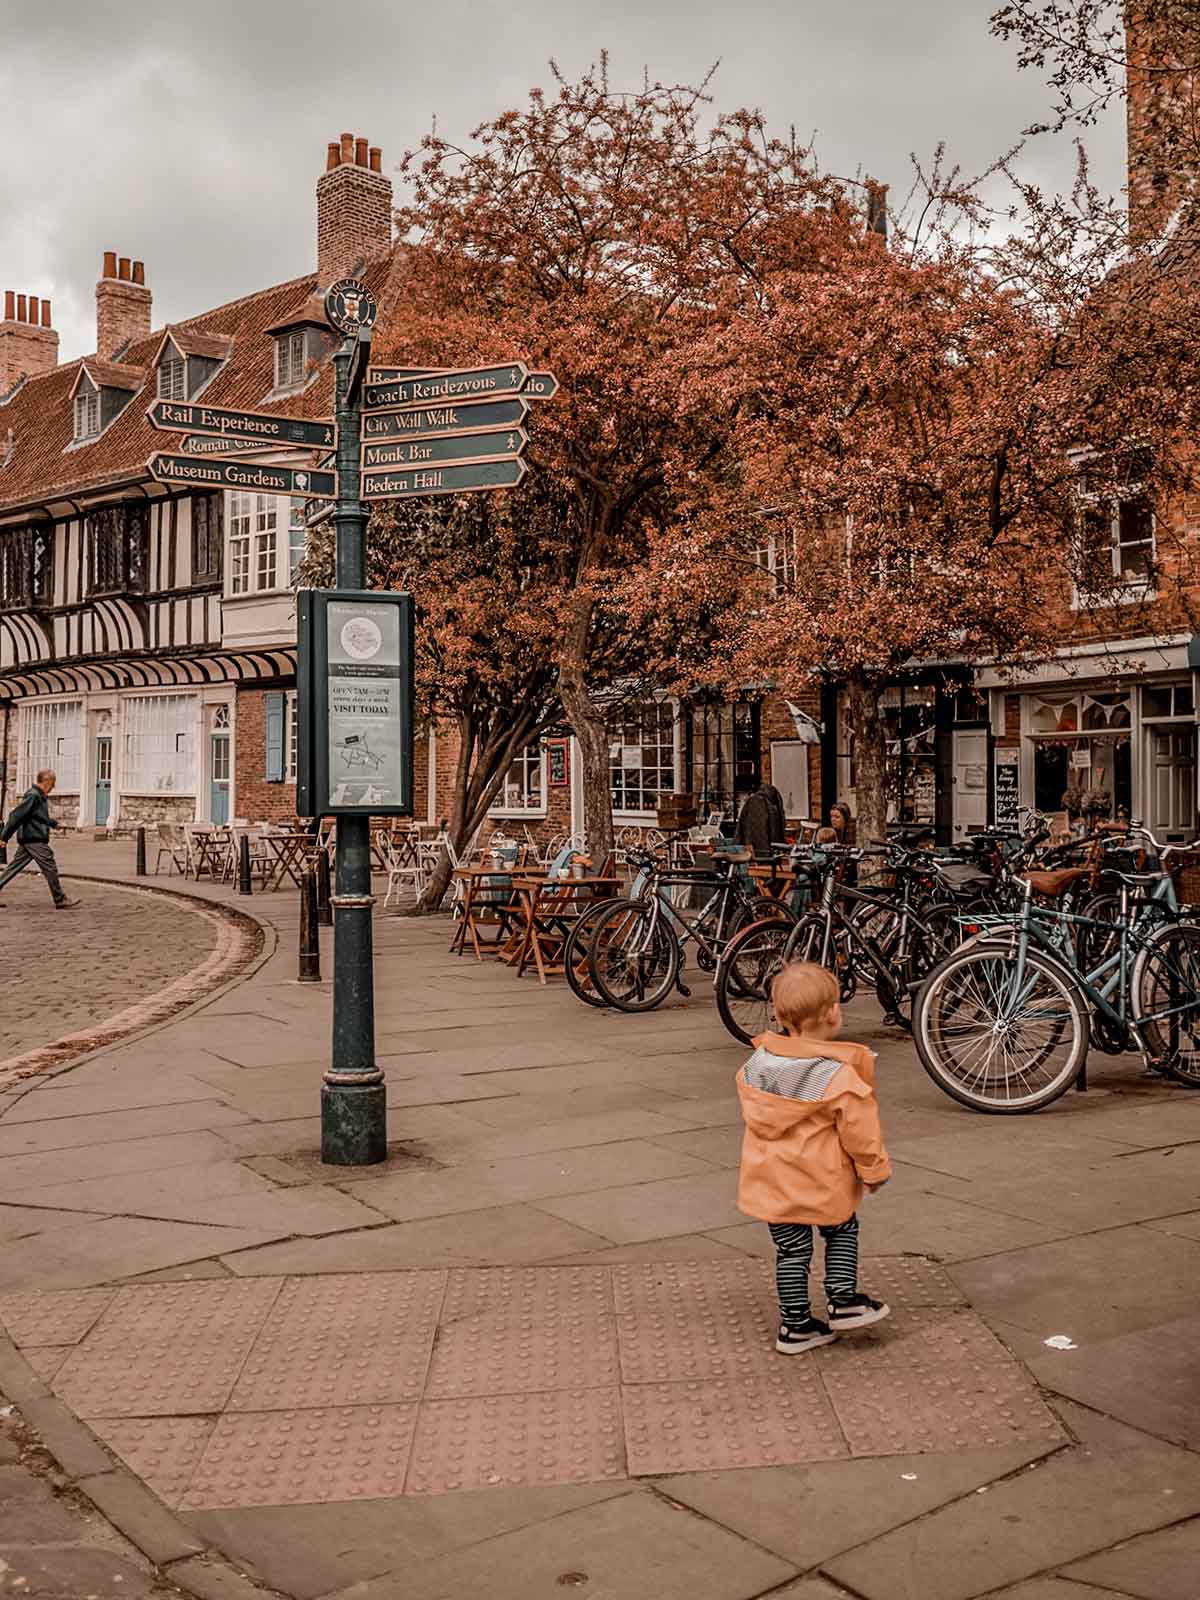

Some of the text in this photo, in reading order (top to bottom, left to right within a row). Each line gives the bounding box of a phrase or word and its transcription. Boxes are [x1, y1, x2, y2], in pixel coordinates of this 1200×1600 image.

[367, 388, 408, 405] Coach
[413, 377, 497, 399] Rendezvous
[160, 404, 280, 434] Rail Experience
[366, 409, 459, 433] City Wall Walk
[188, 438, 229, 453] Roman
[367, 445, 433, 465] Monk Bar
[156, 459, 286, 488] Museum Gardens
[365, 472, 442, 494] Bedern Hall
[361, 705, 388, 713] TODAY
